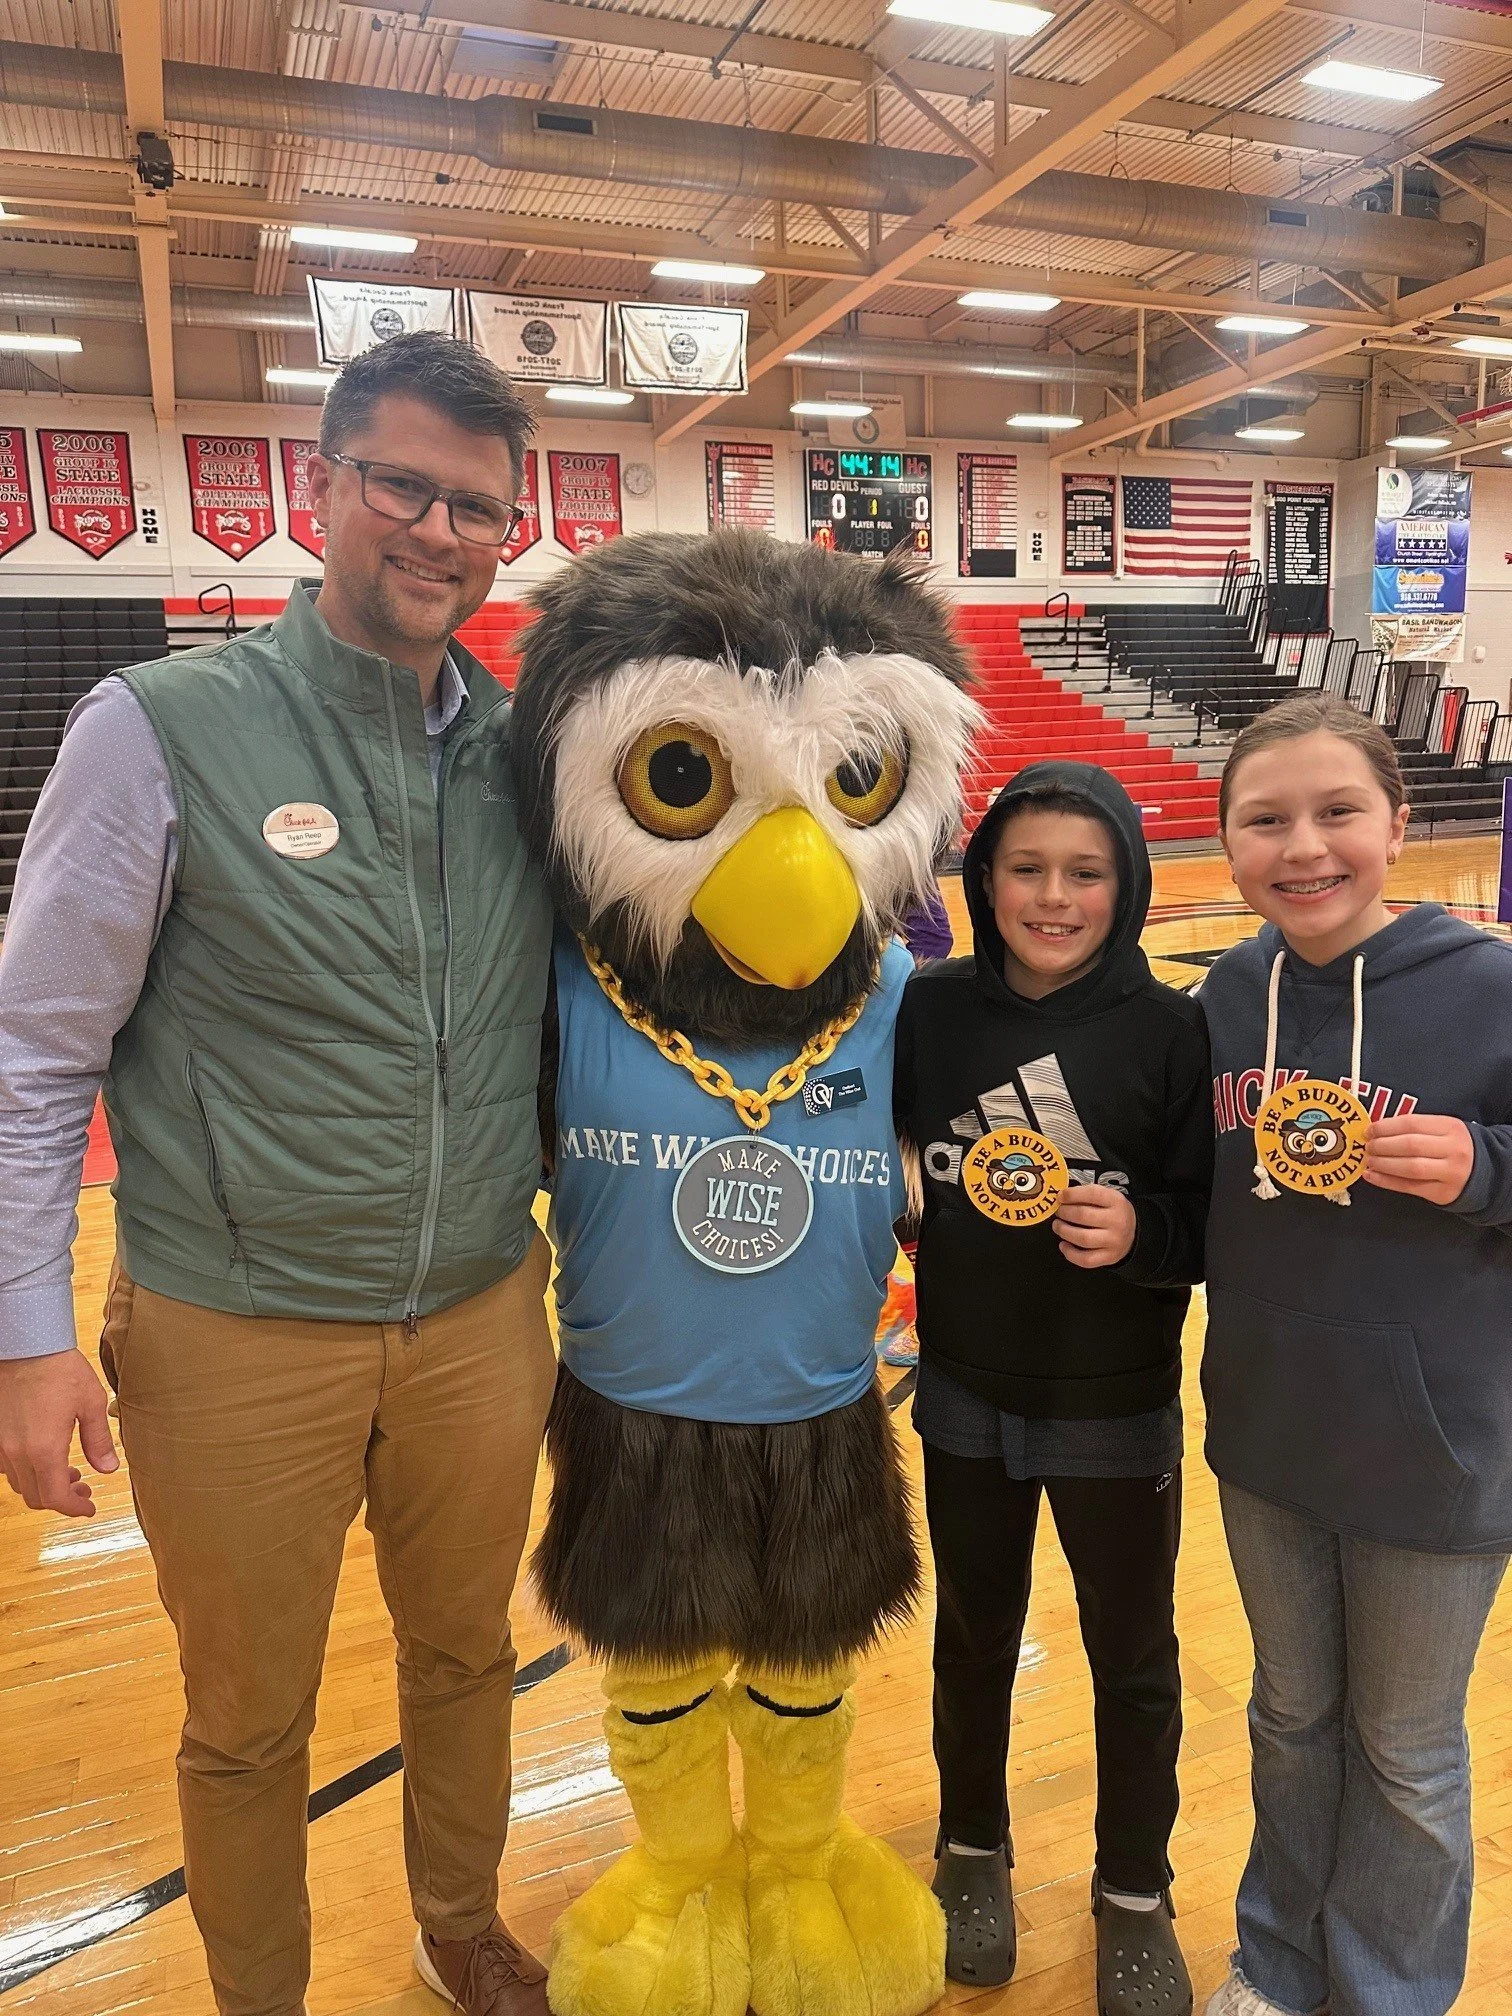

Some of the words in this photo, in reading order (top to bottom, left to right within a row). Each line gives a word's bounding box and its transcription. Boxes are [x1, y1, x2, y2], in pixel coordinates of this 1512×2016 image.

[53, 434, 117, 453] 2006
[198, 440, 258, 458] 2006
[54, 456, 100, 469] GROUP
[103, 458, 120, 470] IV
[198, 462, 243, 474] GROUP
[560, 456, 609, 472] 2007
[841, 453, 900, 478] 44:14
[56, 468, 121, 483] STATE
[200, 472, 262, 487] STATE
[559, 475, 598, 487] GROUP
[57, 485, 122, 497] LACROSSE
[812, 479, 829, 492] RED
[830, 480, 859, 492] DEVILS
[860, 487, 883, 496] PERIOD
[898, 482, 928, 494] GUEST
[1276, 484, 1322, 495] BASKETBALL
[51, 494, 130, 506] CHAMPIONS
[561, 487, 612, 501] STATE
[194, 498, 270, 508] CHAMPIONS
[559, 500, 616, 512] FOOTBALL
[556, 511, 619, 521] CHAMPIONS
[141, 508, 159, 544] HOME
[811, 519, 833, 528] FOULS
[850, 520, 875, 529] PLAYER
[876, 520, 893, 530] FOUL
[910, 521, 931, 531] FOULS
[1399, 522, 1446, 532] AMERICAN
[1032, 532, 1043, 562] HOME
[287, 832, 304, 842] Ryan
[1262, 1108, 1281, 1134] BE
[1282, 1096, 1295, 1110] A
[1297, 1087, 1362, 1125] BUDDY
[558, 1126, 640, 1167] MAKE
[785, 1143, 891, 1187] HOICES
[972, 1146, 992, 1170] BE
[992, 1138, 1005, 1151] A
[1008, 1134, 1061, 1172] BUDDY
[717, 1148, 783, 1180] MAKE
[1265, 1148, 1303, 1182] NOT
[1304, 1174, 1318, 1188] A
[1319, 1140, 1367, 1187] BULLY
[705, 1177, 784, 1227] WISE
[971, 1181, 1000, 1215] NOT
[1000, 1209, 1012, 1221] A
[1015, 1186, 1061, 1221] BULLY
[691, 1218, 786, 1261] CHOICES!
